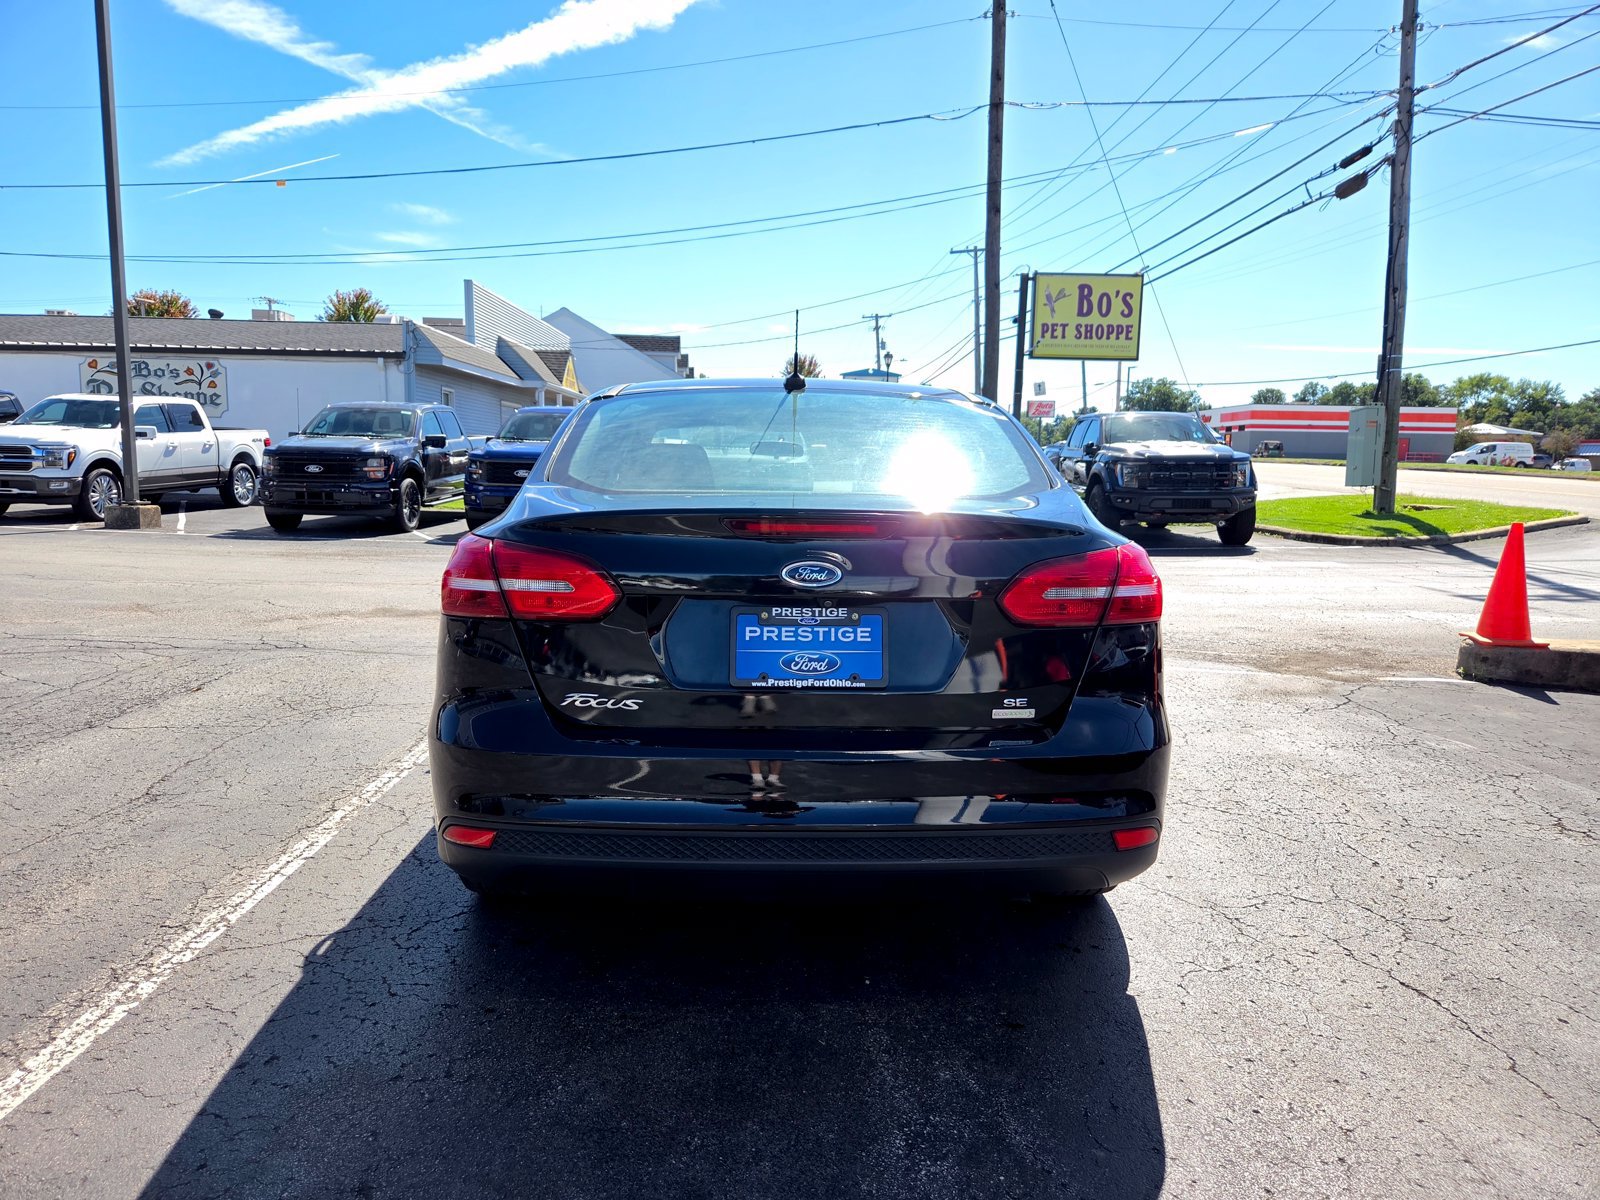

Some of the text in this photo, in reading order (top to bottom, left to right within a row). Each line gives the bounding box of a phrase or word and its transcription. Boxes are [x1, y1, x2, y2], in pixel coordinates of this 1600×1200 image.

[1040, 323, 1134, 341] PET SHOPPE
[131, 360, 181, 379] Bo's
[795, 566, 829, 581] Ford
[772, 607, 848, 617] PRESTIGE
[745, 626, 872, 642] PRESTIGE
[790, 653, 829, 672] Ford
[751, 678, 866, 688] www.PrestigeFordOhio.com
[1003, 698, 1028, 708] SE
